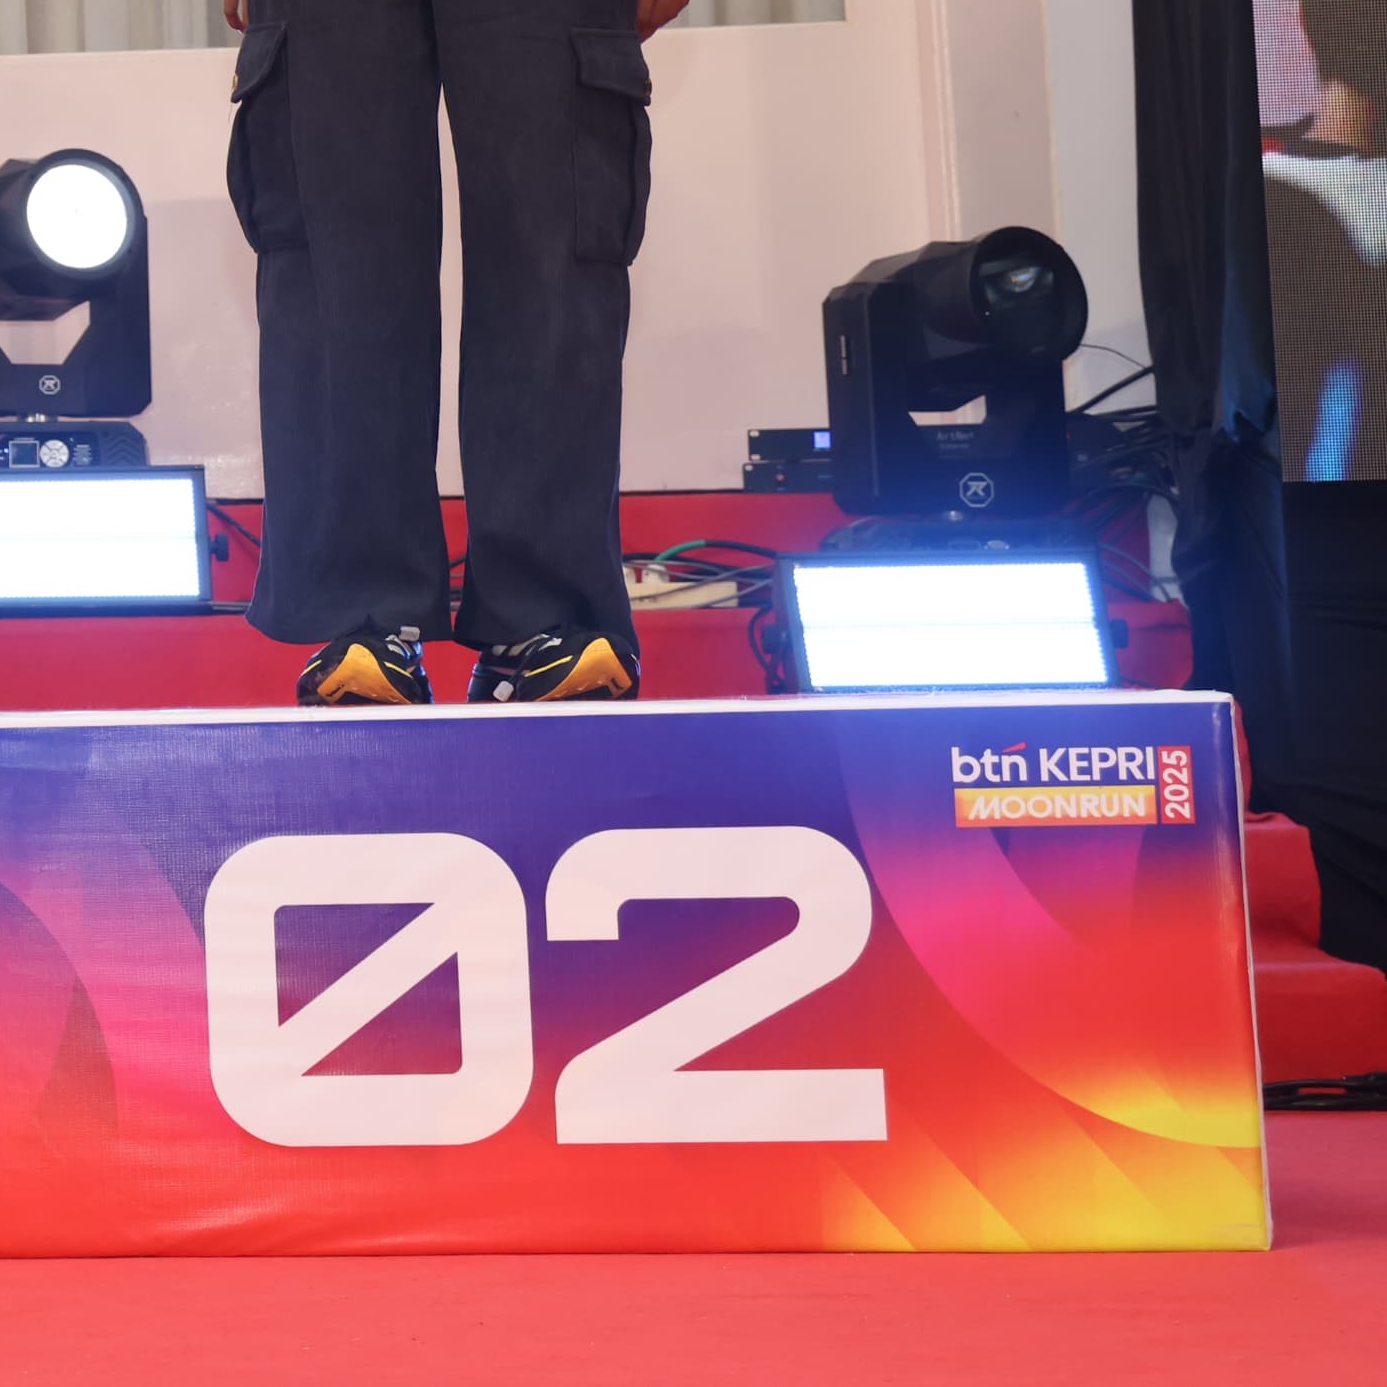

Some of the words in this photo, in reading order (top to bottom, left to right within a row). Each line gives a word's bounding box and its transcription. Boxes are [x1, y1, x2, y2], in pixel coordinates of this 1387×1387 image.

[951, 742, 1027, 782] btn
[1039, 746, 1155, 782] KEPRI
[1161, 750, 1191, 819] 2025
[968, 792, 1146, 820] MOONRUN
[204, 825, 888, 1147] 02
